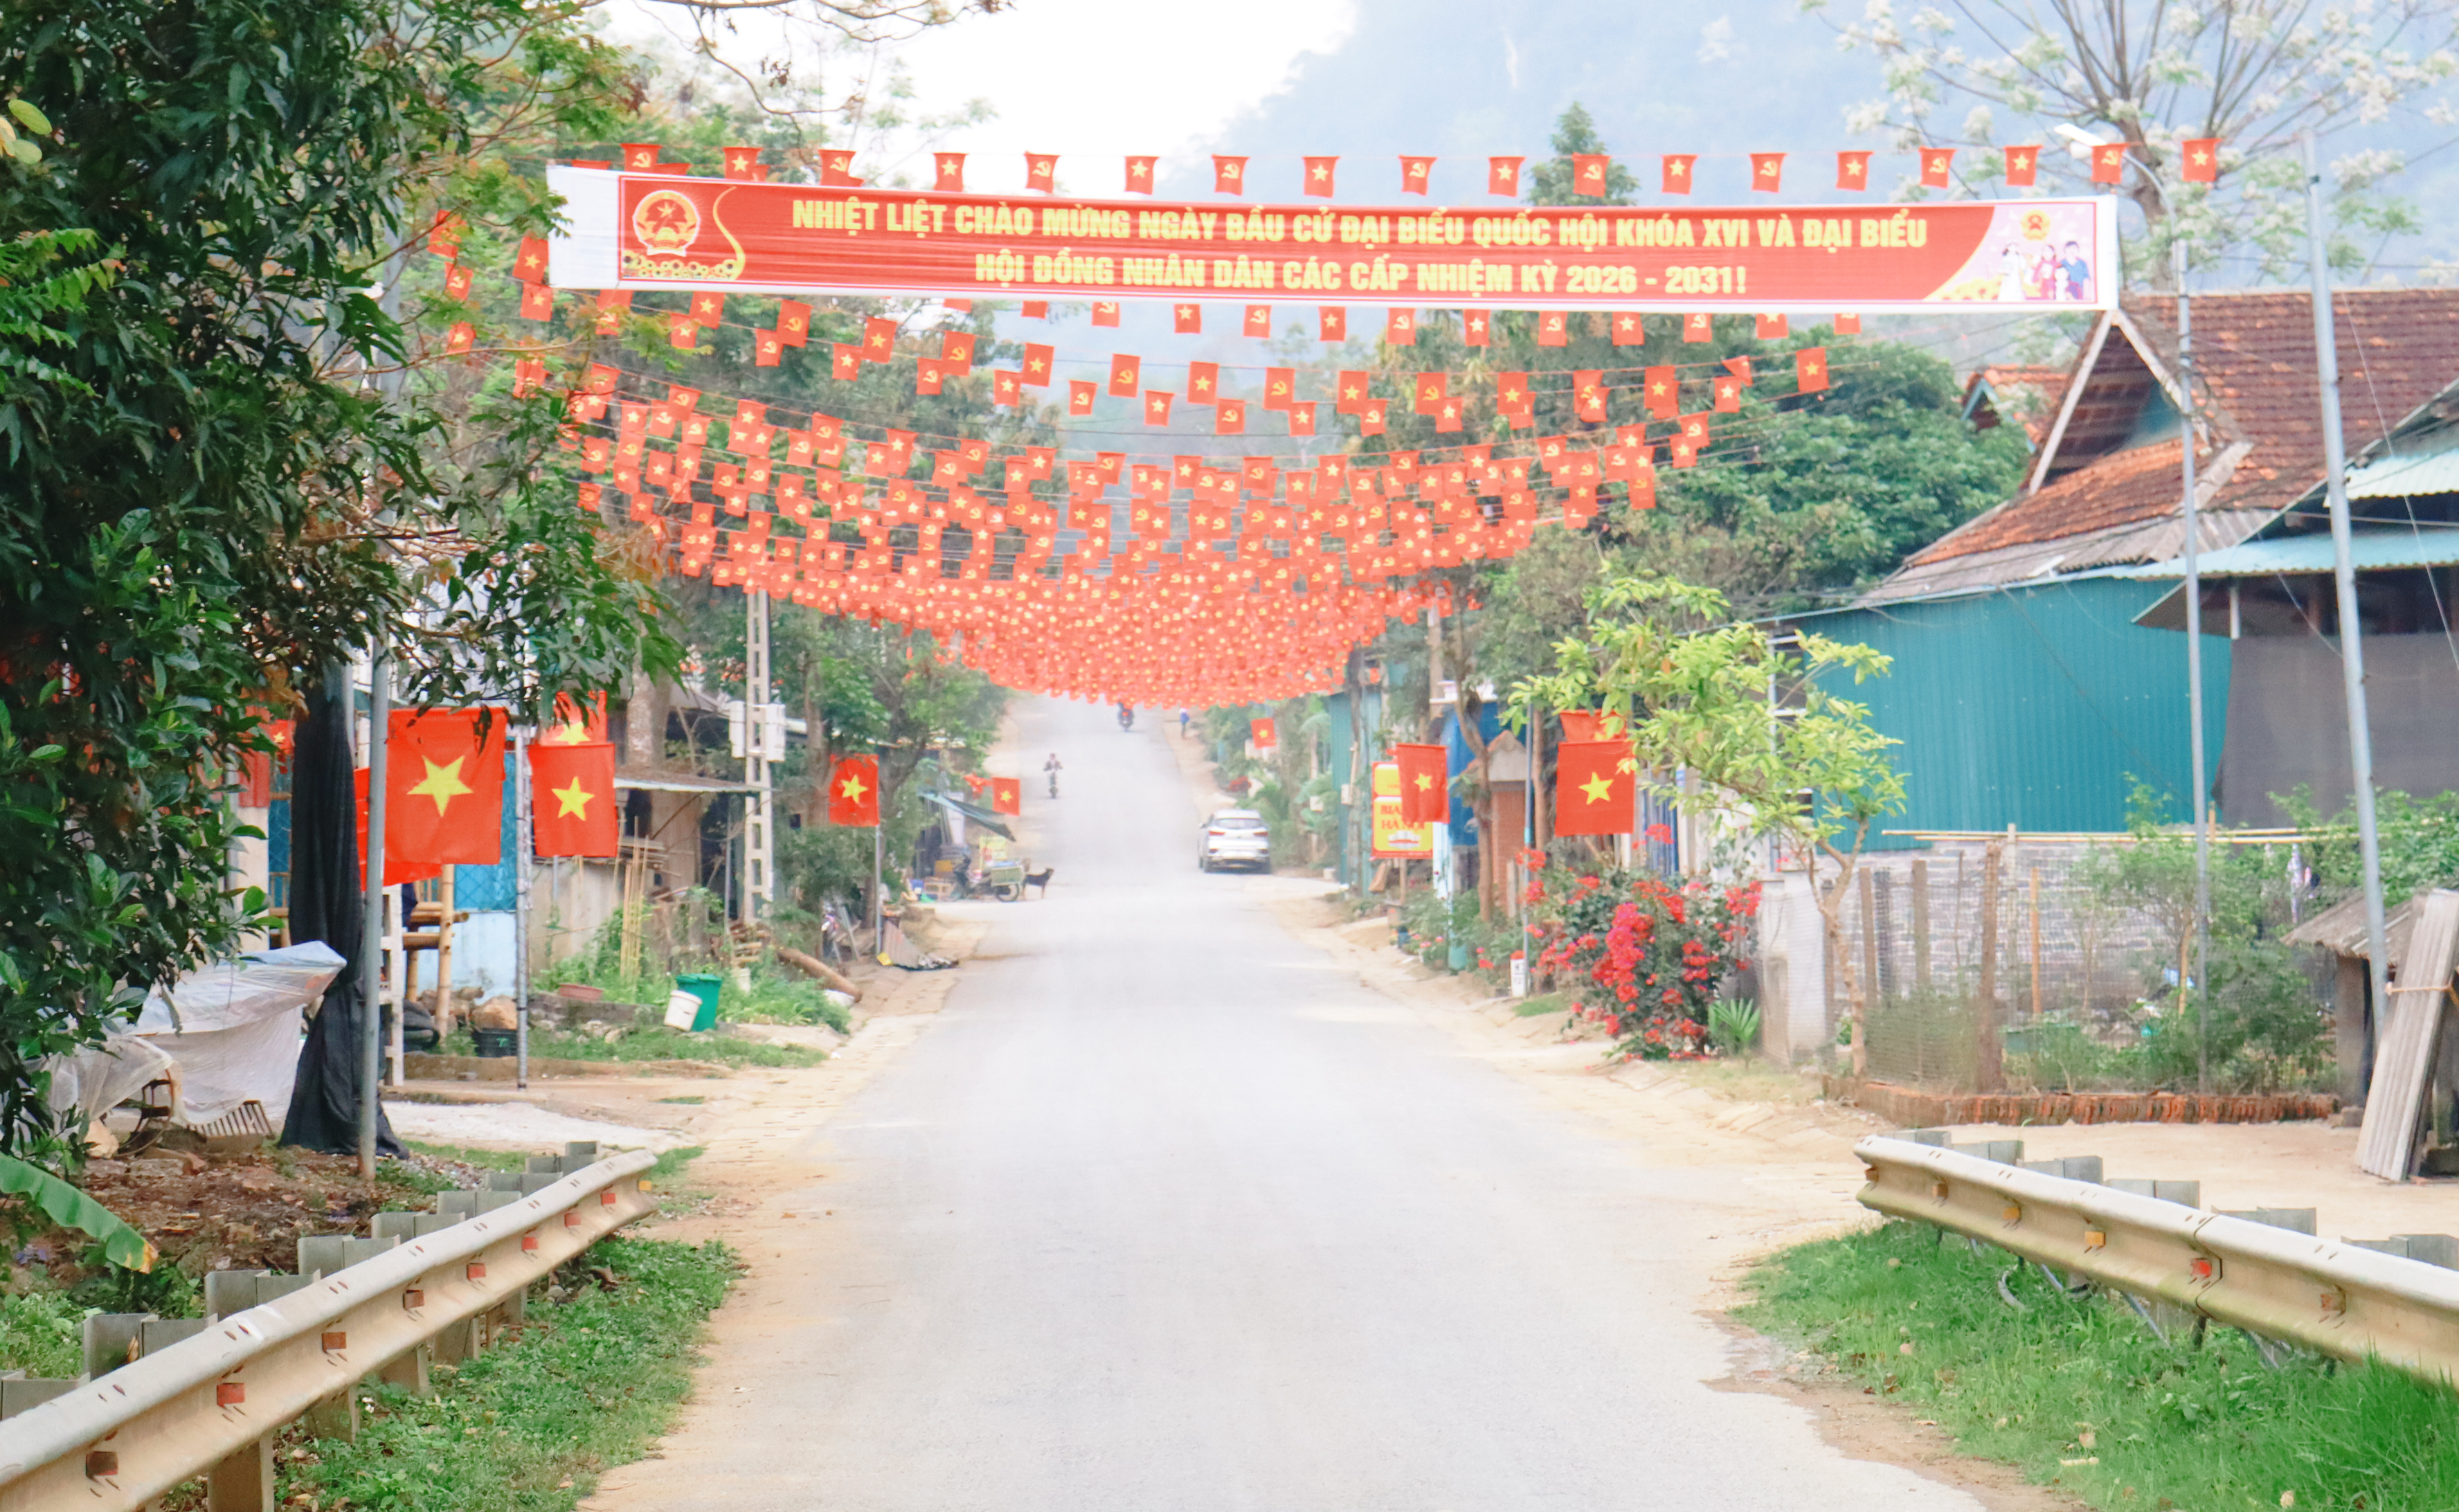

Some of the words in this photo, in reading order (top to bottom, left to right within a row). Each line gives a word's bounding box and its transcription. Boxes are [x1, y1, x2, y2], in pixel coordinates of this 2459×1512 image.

[793, 196, 879, 235] NHIỆT
[887, 199, 947, 238] LIỆT
[955, 201, 1034, 235] CHÀO
[1042, 204, 1131, 238] MỪNG
[1139, 207, 1217, 240] NGÀY
[1225, 204, 1285, 242] BẦU
[1292, 206, 1335, 242] CỬ
[1339, 215, 1389, 249] ĐẠI
[1398, 206, 1464, 244] BIỂU
[1472, 208, 1551, 248] QUỐC
[1559, 213, 1608, 252] HỘI
[1616, 213, 1695, 247] KHÓA
[1702, 219, 1749, 247] XVI
[1757, 213, 1796, 247] VÀ
[1801, 219, 1852, 253] ĐẠI
[1860, 208, 1927, 248] BIỂU
[975, 249, 1025, 288] HỘI
[1032, 247, 1114, 285] ĐỒNG
[1122, 253, 1205, 287] NHÂN
[1214, 255, 1274, 289] DÂN
[1282, 256, 1341, 290] CÁC
[1349, 253, 1409, 291] CẤP
[1417, 258, 1513, 298] NHIỆM
[1520, 259, 1558, 293] KỲ
[1566, 265, 1637, 294] 2026
[1644, 277, 1657, 285] -
[1665, 266, 1746, 294] 2031!
[1381, 818, 1399, 830] HÀ
